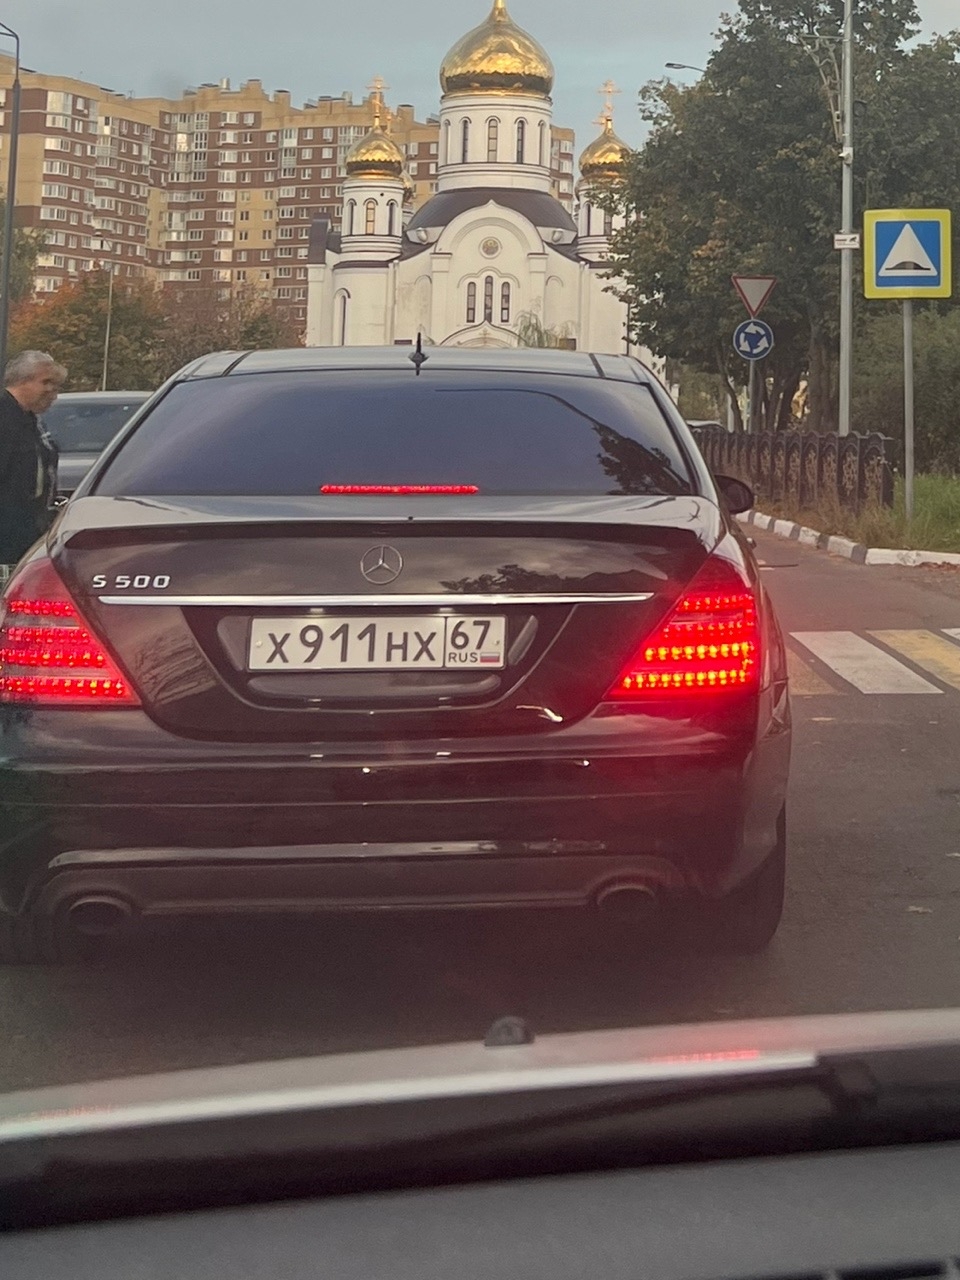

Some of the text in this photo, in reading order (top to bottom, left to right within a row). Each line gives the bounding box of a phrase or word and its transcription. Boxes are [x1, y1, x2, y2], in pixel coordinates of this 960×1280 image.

[92, 574, 171, 588] S 500
[450, 620, 491, 650] 67
[448, 652, 478, 663] RUS
